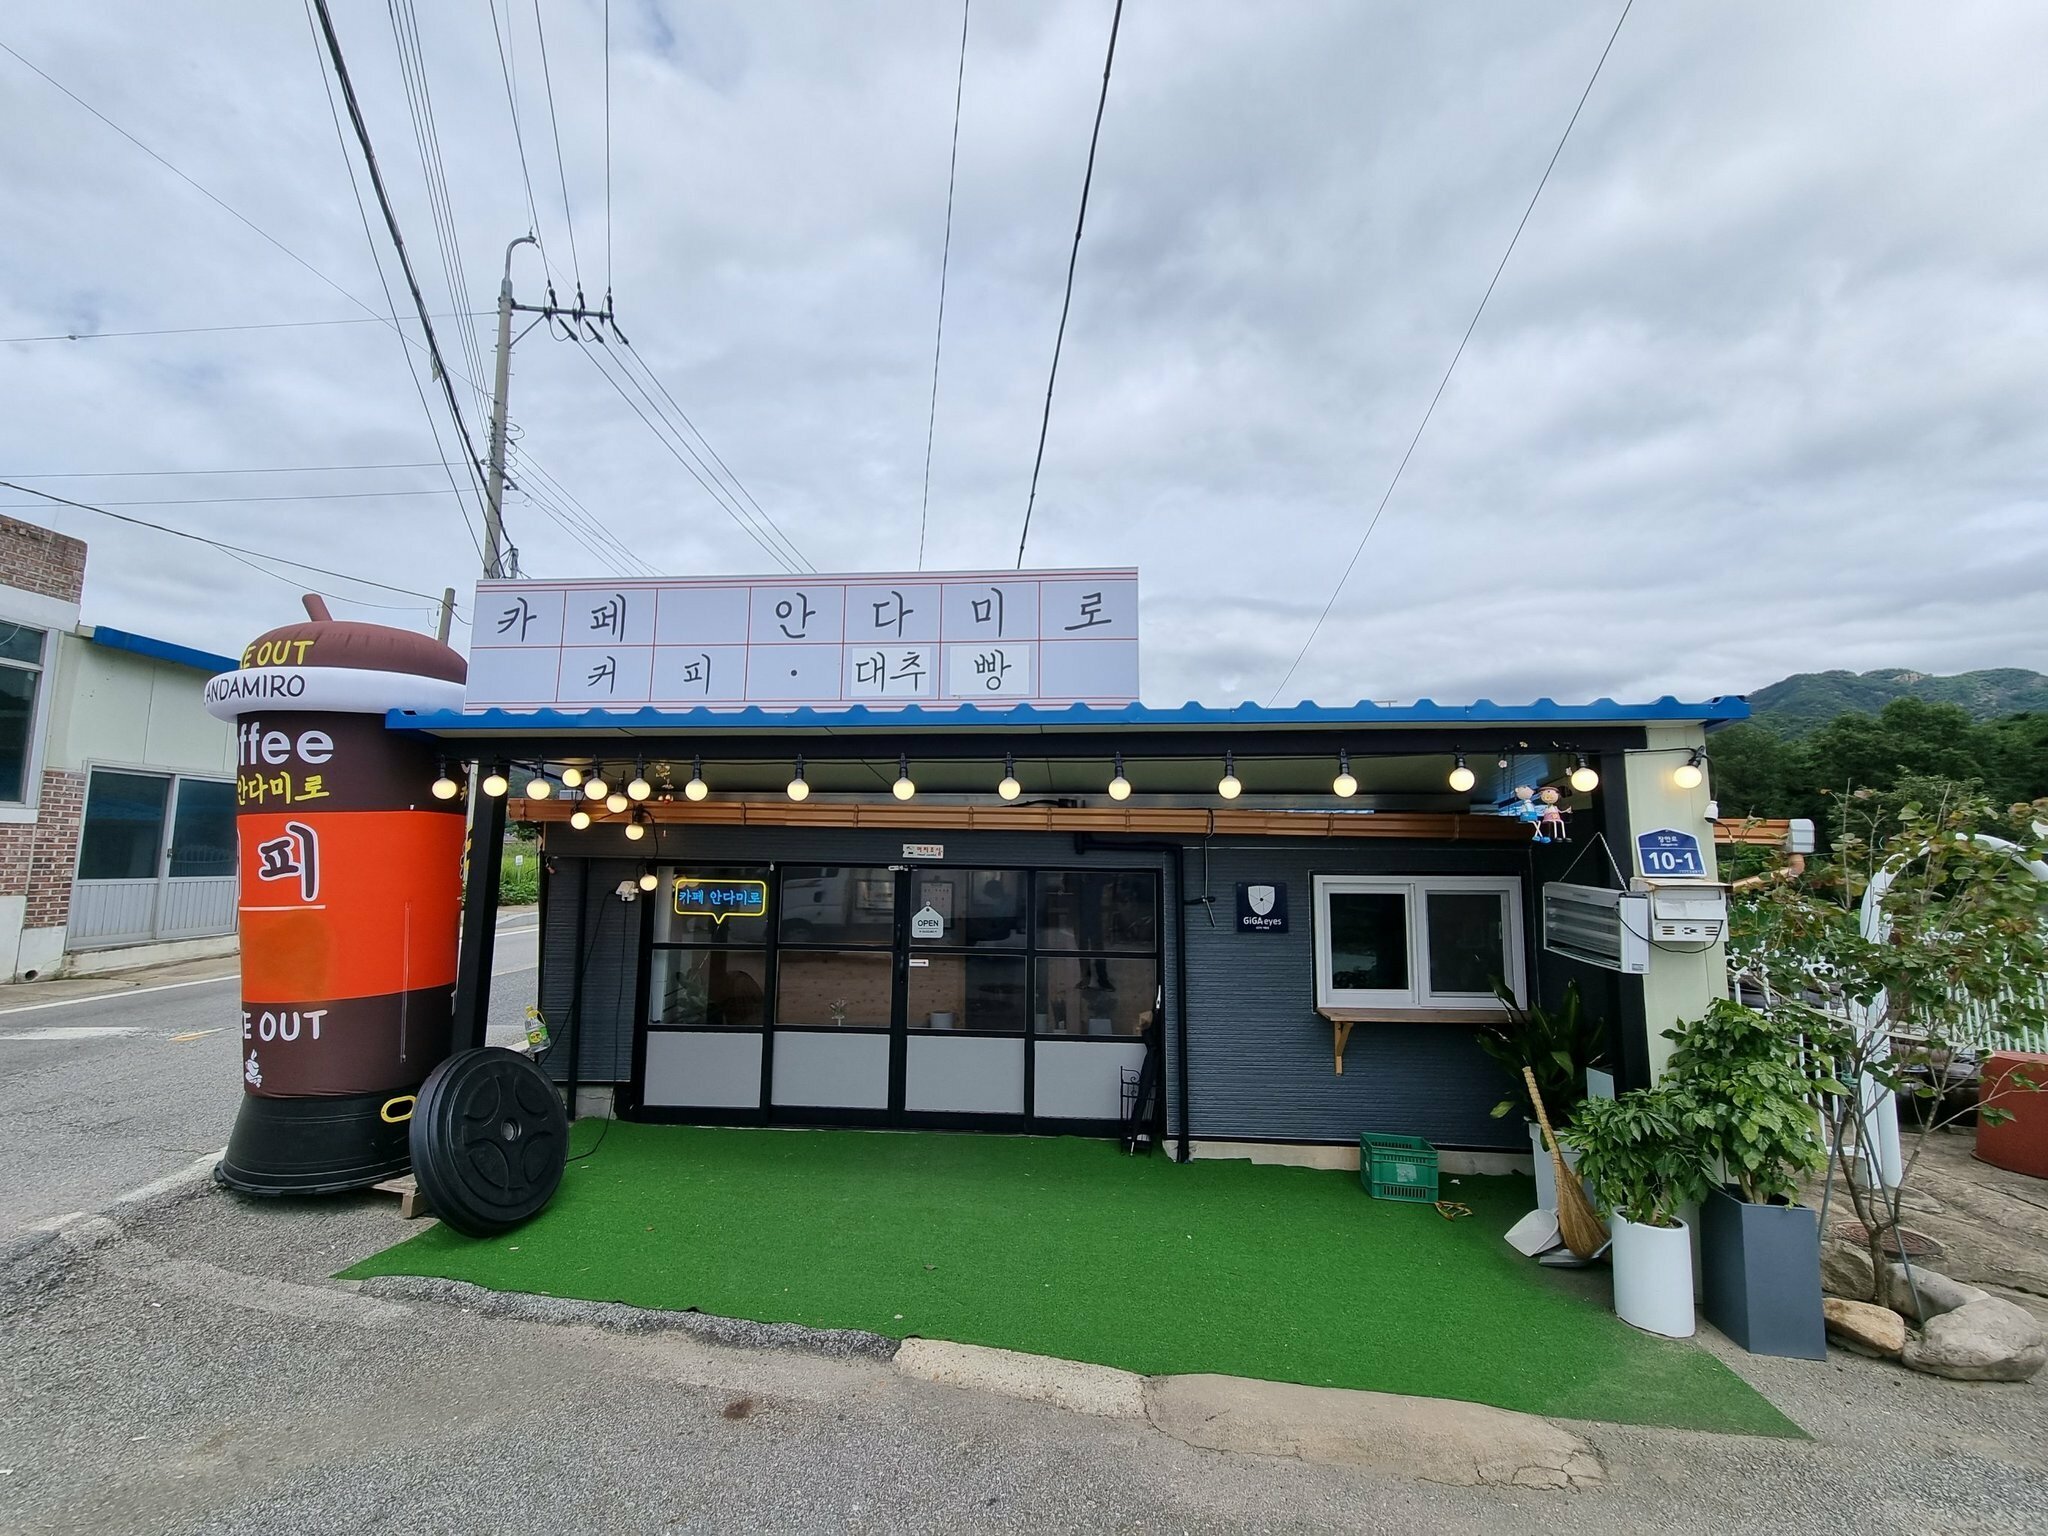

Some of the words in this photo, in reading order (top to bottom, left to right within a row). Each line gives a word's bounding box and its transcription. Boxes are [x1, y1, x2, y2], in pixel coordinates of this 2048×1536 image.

[497, 593, 626, 642] 카페
[775, 587, 1112, 639] 안다미로
[241, 645, 258, 669] E
[257, 640, 315, 666] OUT
[206, 674, 305, 701] ANDAMIRO
[587, 653, 711, 695] 커피
[237, 771, 330, 806] 안다미로
[1648, 851, 1696, 870] 10-1
[678, 888, 704, 905] 카페
[709, 888, 763, 906] 안다미로
[917, 919, 939, 927] OPEN
[1263, 918, 1282, 928] eyes
[259, 1009, 329, 1042] OUT
